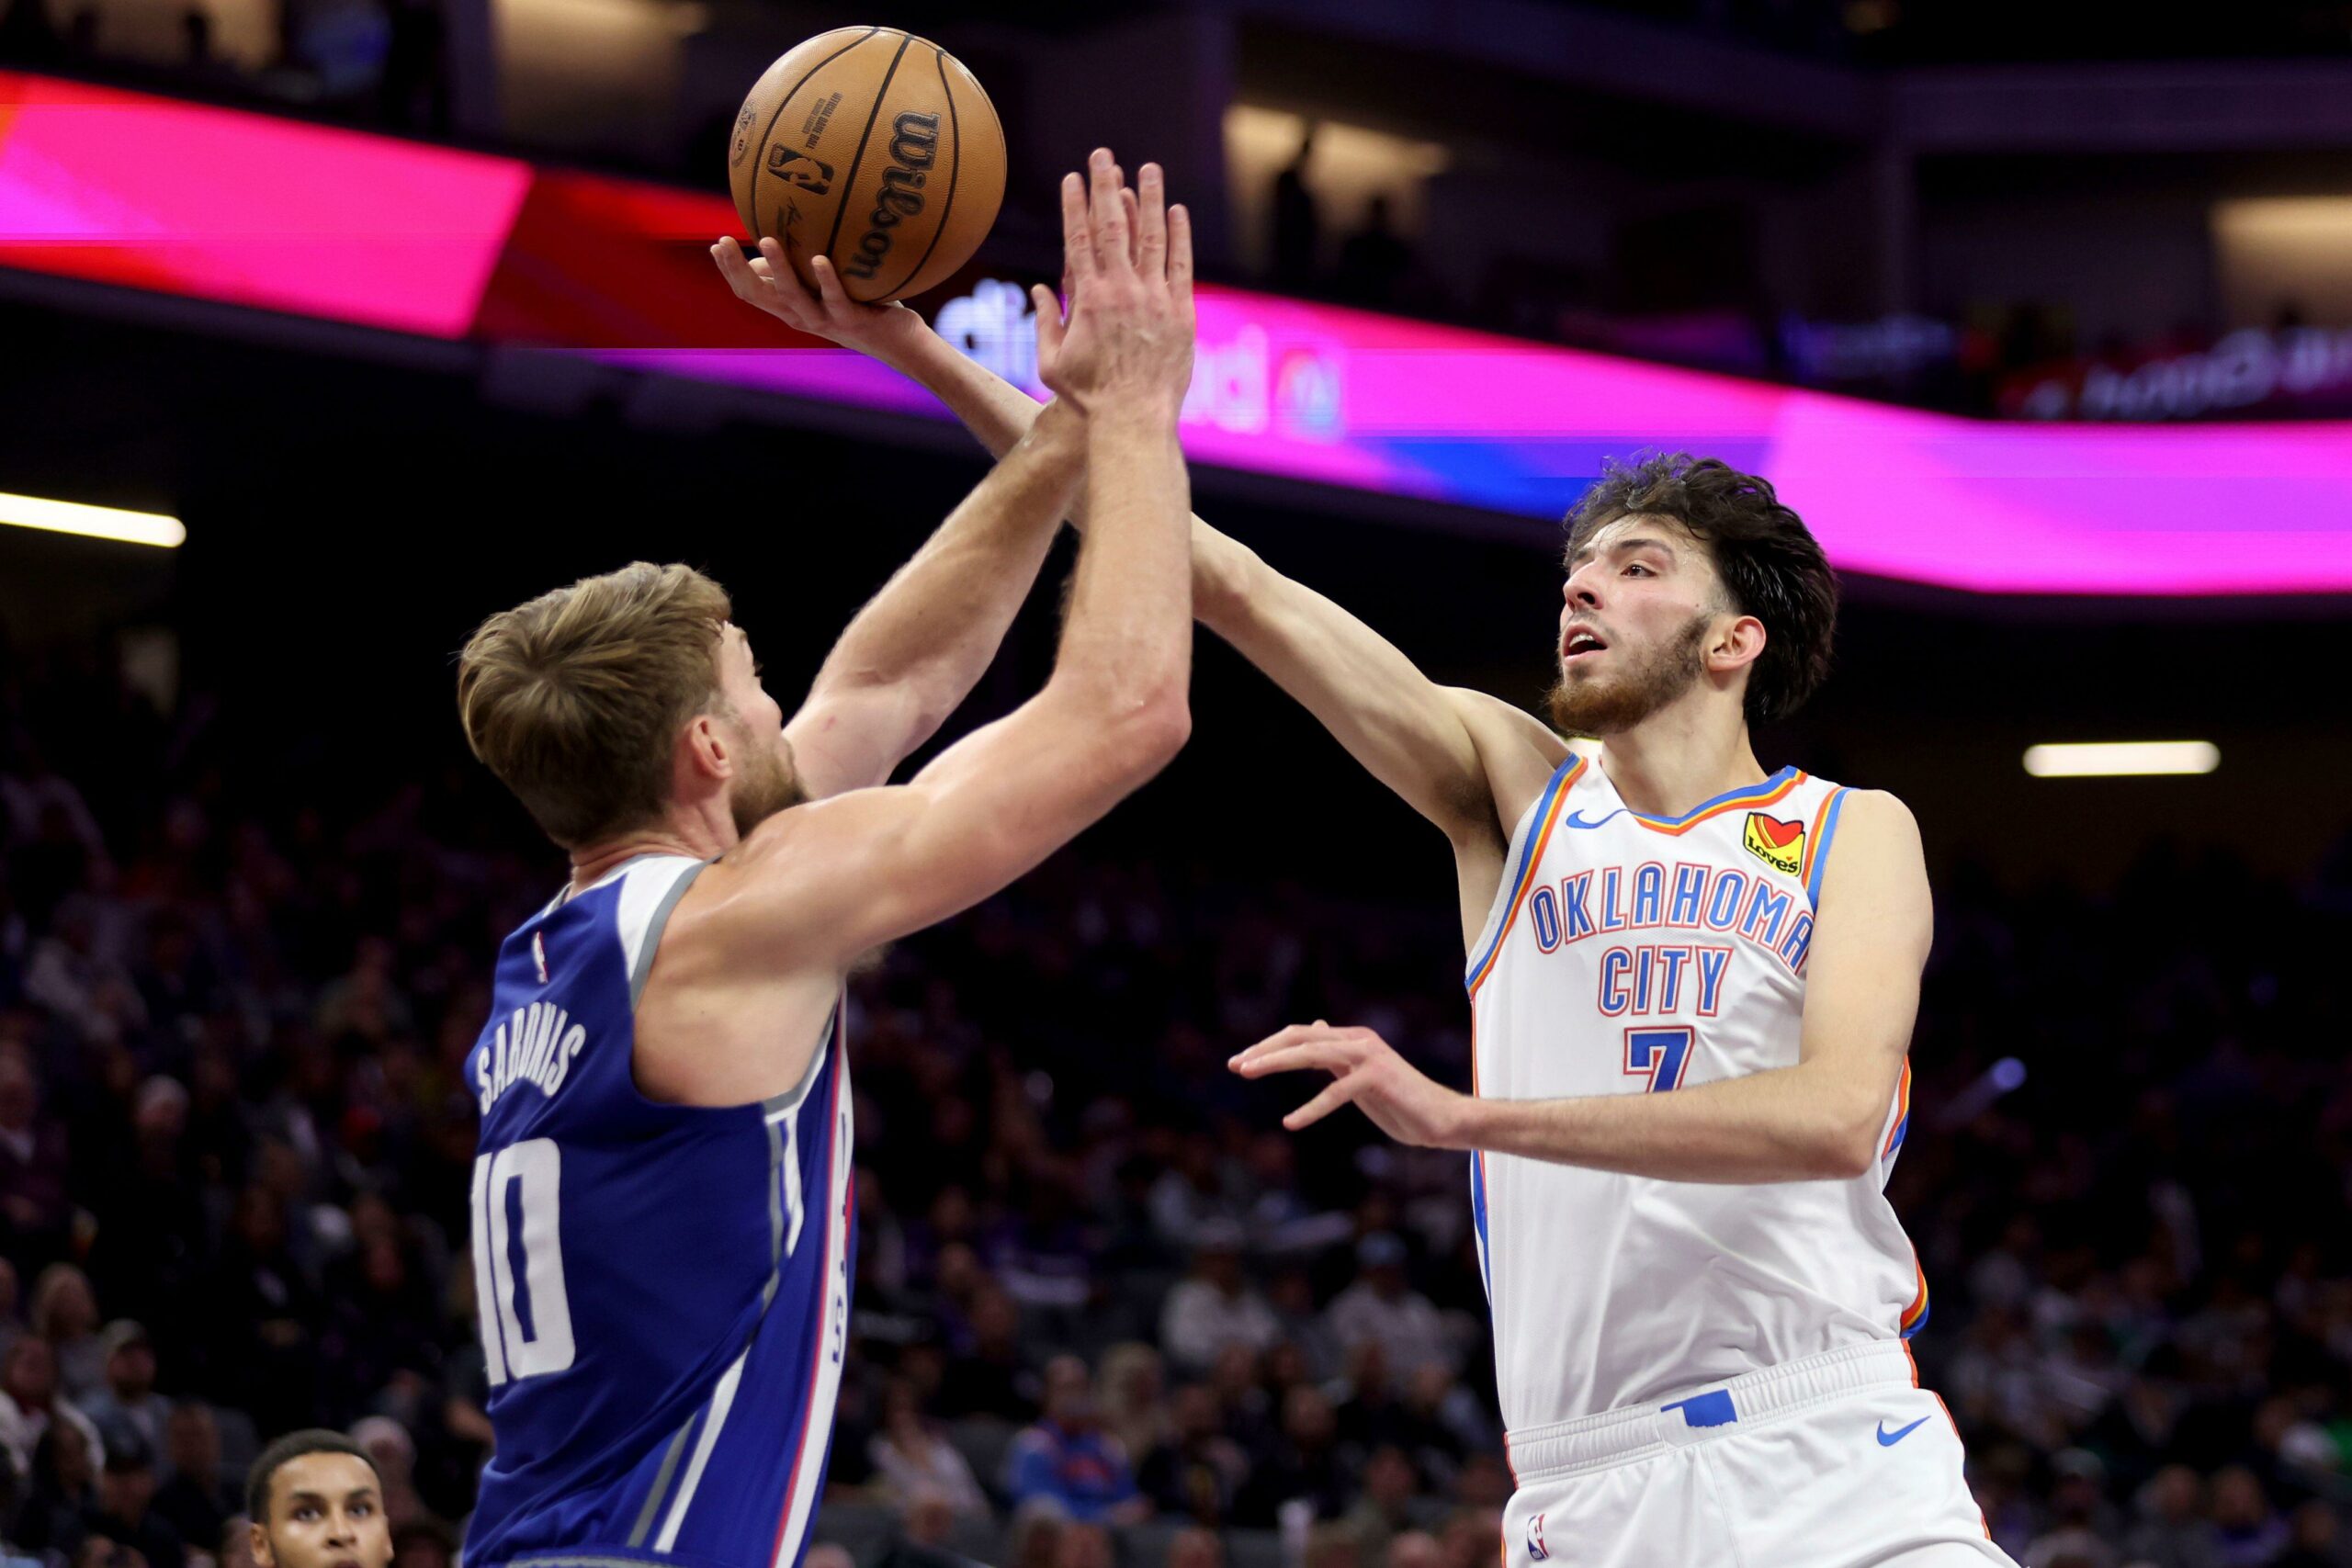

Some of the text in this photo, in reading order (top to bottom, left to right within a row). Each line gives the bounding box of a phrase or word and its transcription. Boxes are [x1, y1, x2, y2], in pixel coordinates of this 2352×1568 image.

[843, 110, 942, 280] Wilson
[1529, 861, 1815, 976] OKLAHOMA
[1598, 944, 1734, 1017] CITY
[476, 1000, 586, 1117] SABONIS
[1623, 1024, 1695, 1094] 7
[471, 1136, 576, 1387] 10
